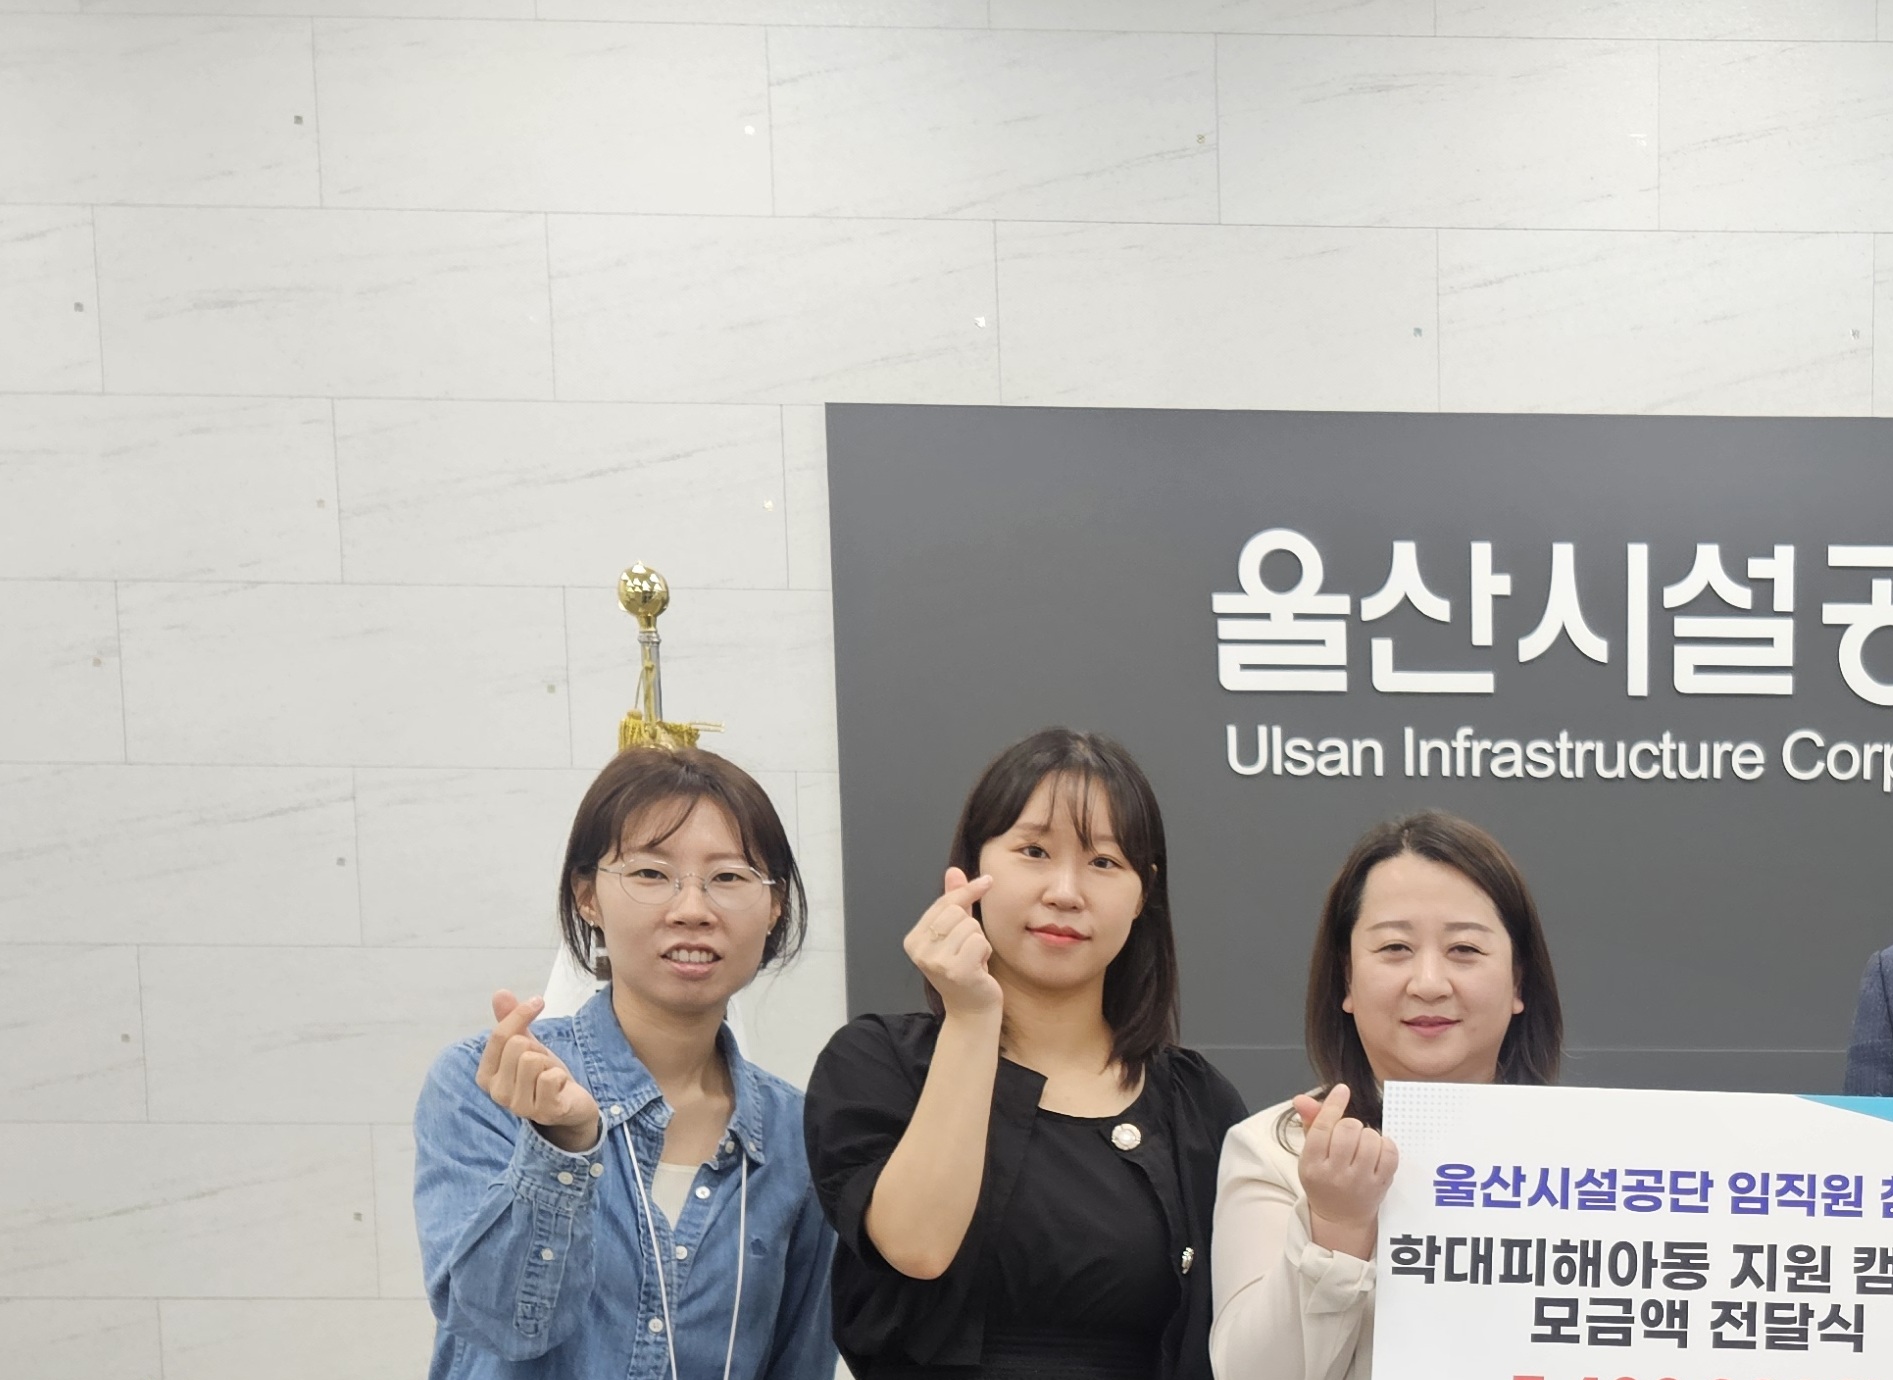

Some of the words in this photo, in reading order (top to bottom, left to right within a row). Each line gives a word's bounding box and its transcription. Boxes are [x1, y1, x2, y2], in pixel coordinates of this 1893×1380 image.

[1226, 725, 1384, 777] Ulsan
[1404, 727, 1765, 780] Infrastructure
[1432, 1163, 1715, 1214] 울산시설공단
[1727, 1171, 1864, 1219] 임직원
[1389, 1233, 1711, 1291] 학대피해아동
[1730, 1243, 1832, 1294] 지원
[1530, 1297, 1689, 1349] 모금액
[1709, 1300, 1865, 1353] 전달식
